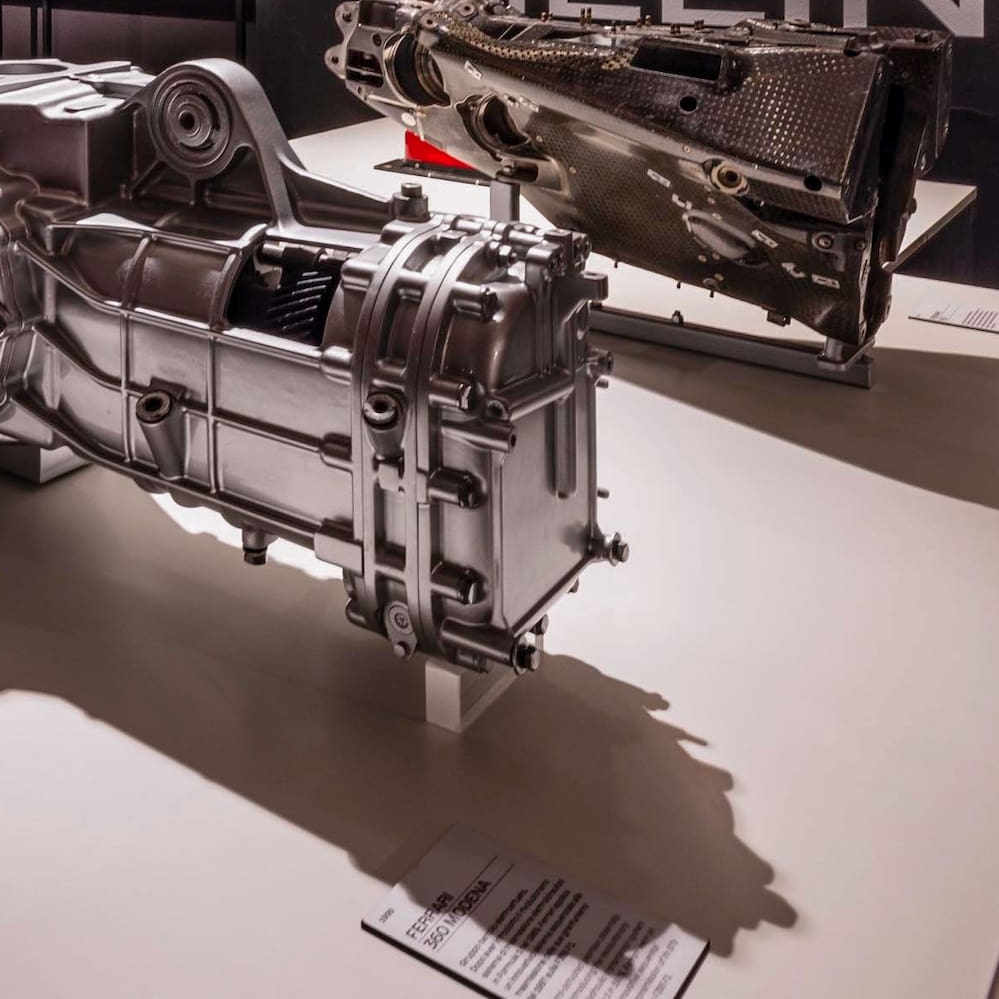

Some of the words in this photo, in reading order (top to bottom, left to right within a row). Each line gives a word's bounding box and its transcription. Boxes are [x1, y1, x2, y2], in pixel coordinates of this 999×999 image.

[406, 891, 453, 940] FERRARI
[423, 923, 450, 950] 360
[447, 879, 493, 929] MODENA
